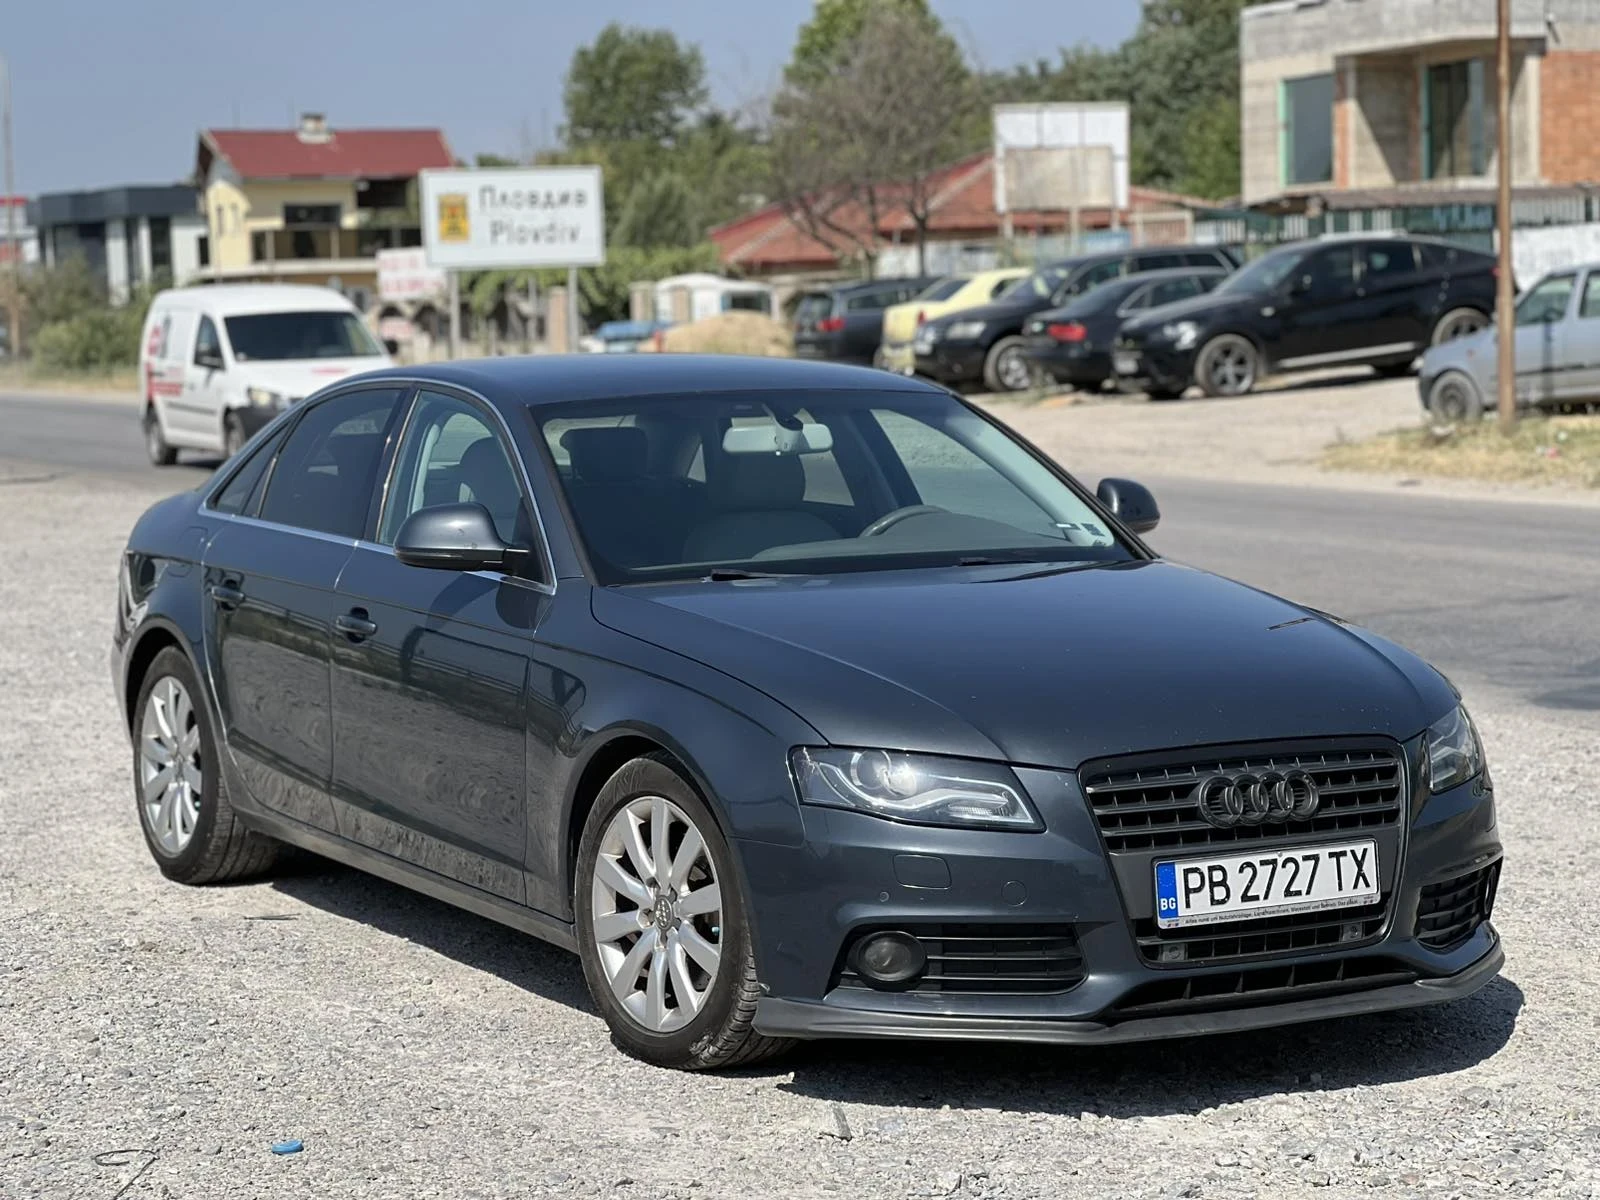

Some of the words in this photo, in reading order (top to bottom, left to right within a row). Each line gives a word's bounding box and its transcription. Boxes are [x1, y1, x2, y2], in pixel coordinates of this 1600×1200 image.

[479, 184, 588, 212] Пловдив
[490, 218, 581, 245] Plovdiv
[1182, 864, 1231, 909] PB
[1238, 854, 1321, 903] 2727
[1328, 847, 1371, 892] TX
[1160, 897, 1178, 911] BG
